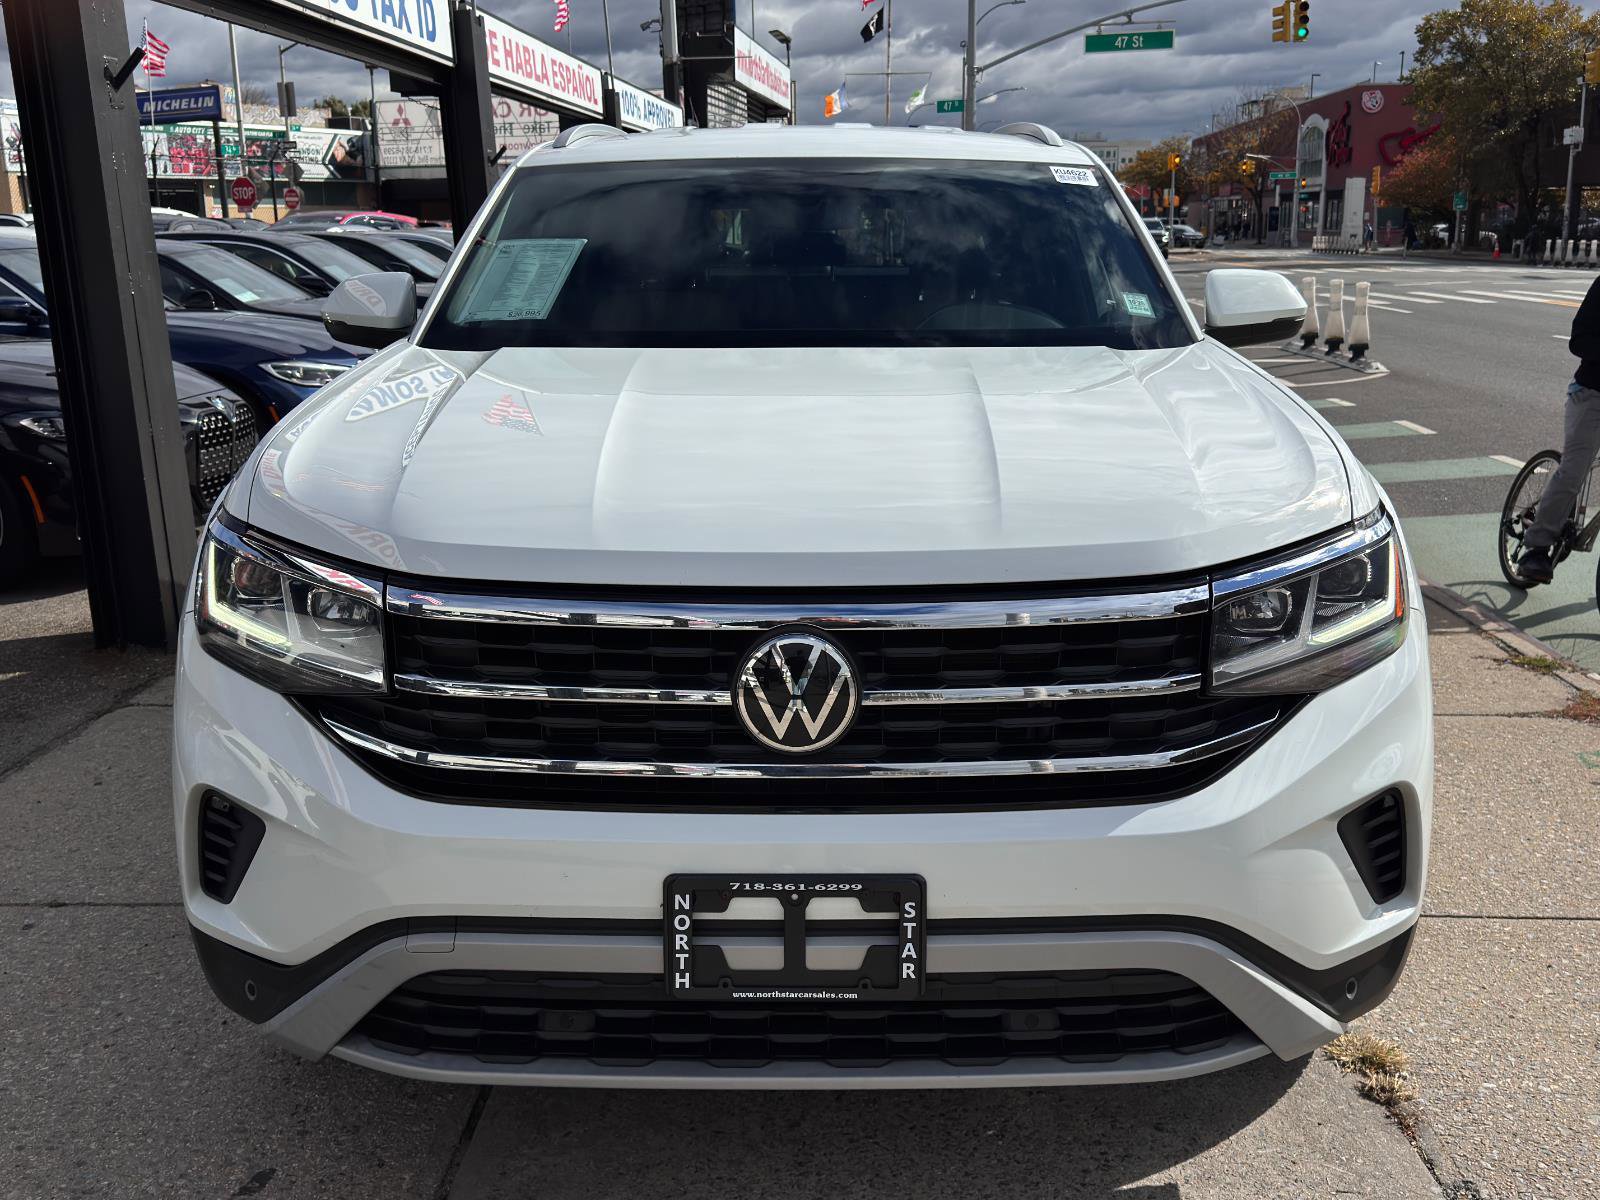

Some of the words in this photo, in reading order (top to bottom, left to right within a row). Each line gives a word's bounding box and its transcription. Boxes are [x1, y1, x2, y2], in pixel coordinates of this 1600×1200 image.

[416, 0, 437, 43] ID
[1114, 37, 1129, 48] 47
[1132, 35, 1144, 48] St
[486, 29, 501, 68] E
[502, 35, 550, 86] HABLA
[551, 57, 599, 106] ESPAÑOL
[143, 96, 214, 113] MICHELIN
[621, 89, 641, 121] 100%
[643, 99, 676, 128] APPROVED
[943, 101, 953, 111] 47
[174, 126, 192, 134] AUTO
[192, 127, 206, 135] CITY
[233, 187, 254, 199] STOP
[729, 882, 863, 891] 718-361-6299
[674, 894, 691, 989] NORTH
[902, 902, 918, 979] STAR
[732, 990, 858, 999] www.northstarcarsales.com
